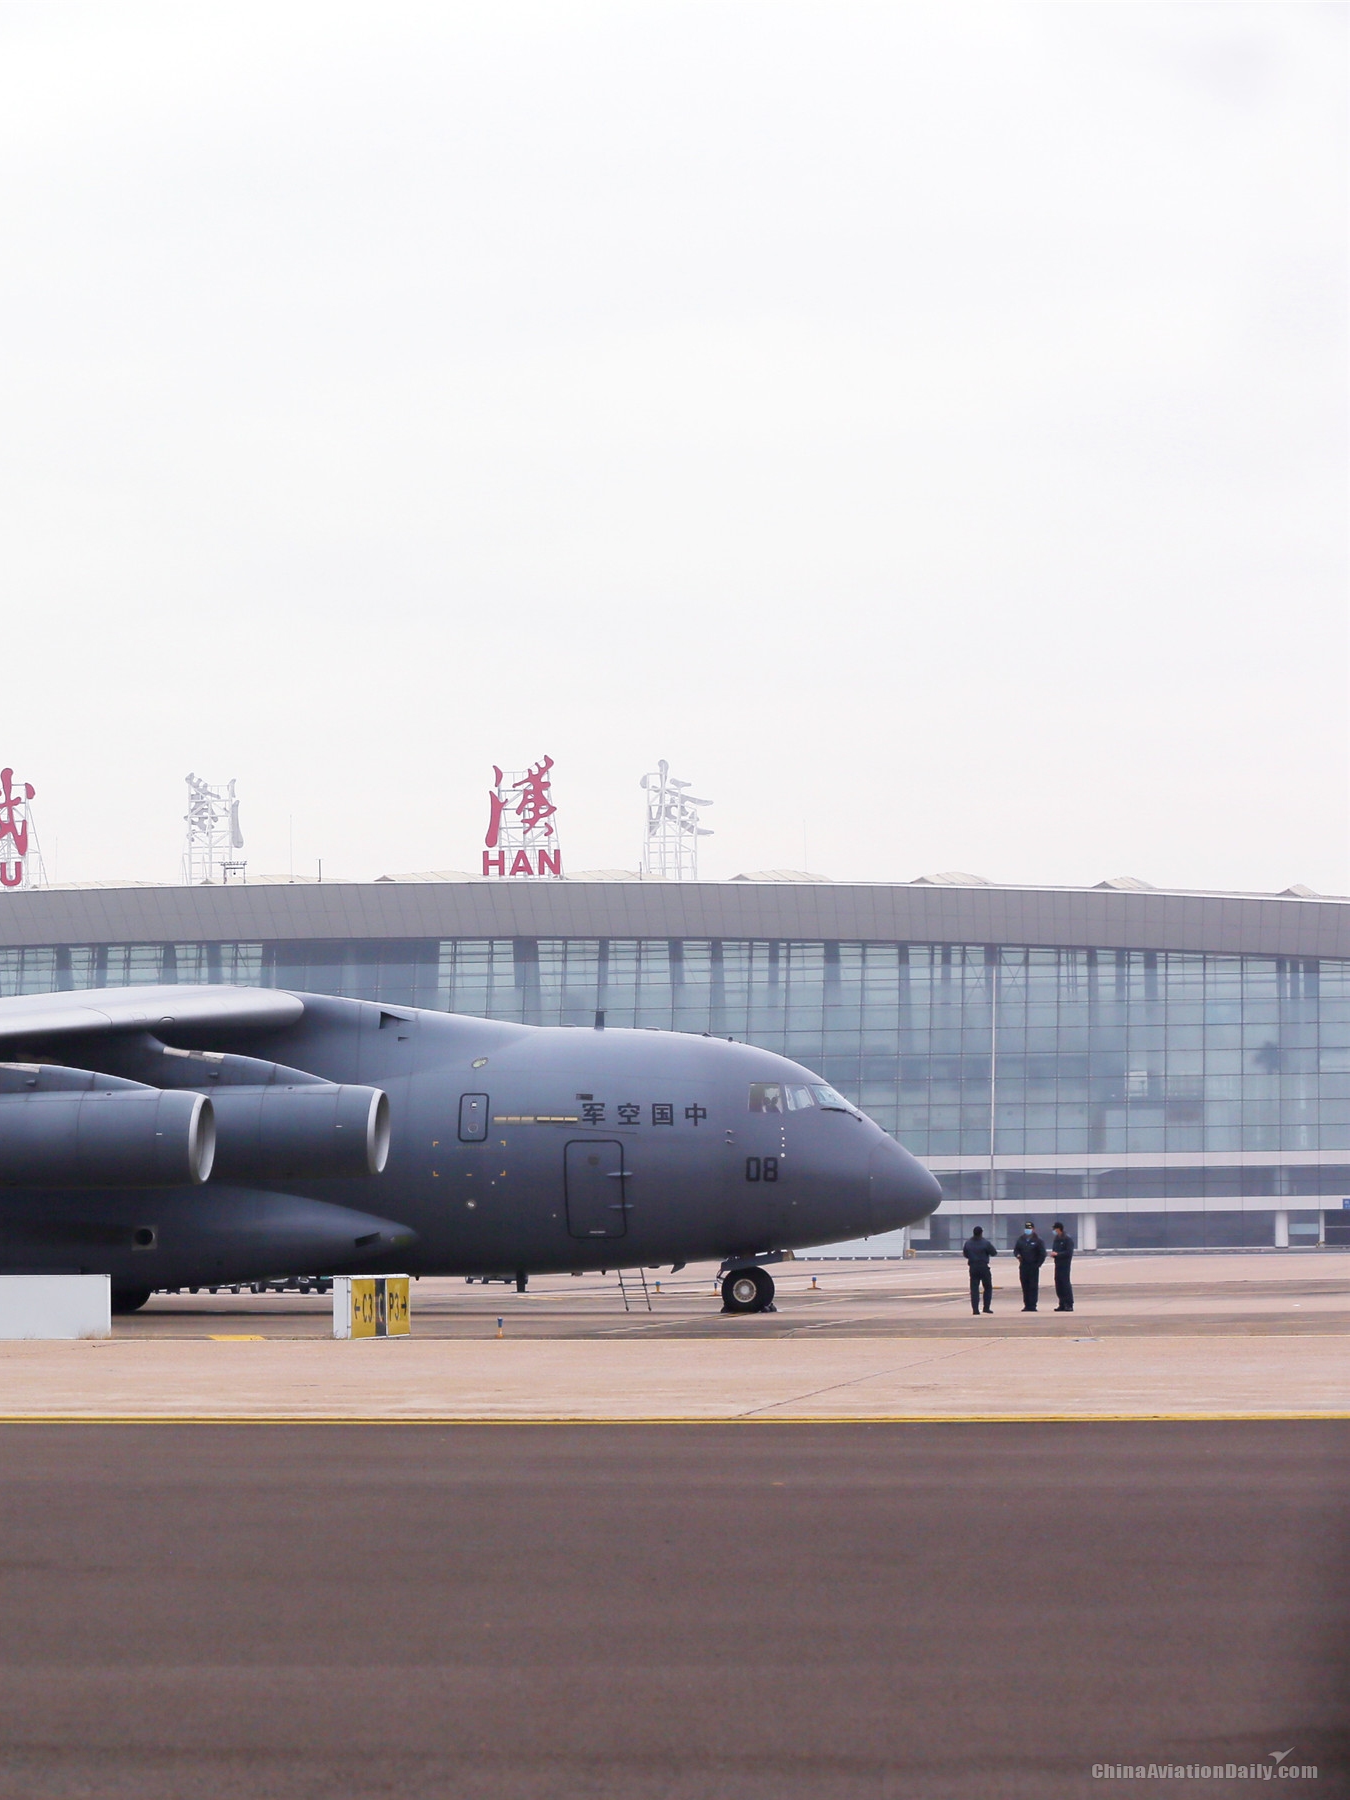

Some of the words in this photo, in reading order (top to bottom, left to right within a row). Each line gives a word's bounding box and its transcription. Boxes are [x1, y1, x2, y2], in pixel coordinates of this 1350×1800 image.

[485, 755, 557, 848] 漢
[482, 849, 561, 876] HAN
[746, 1157, 778, 1182] 08
[362, 1293, 373, 1323] C3
[388, 1292, 400, 1322] P3
